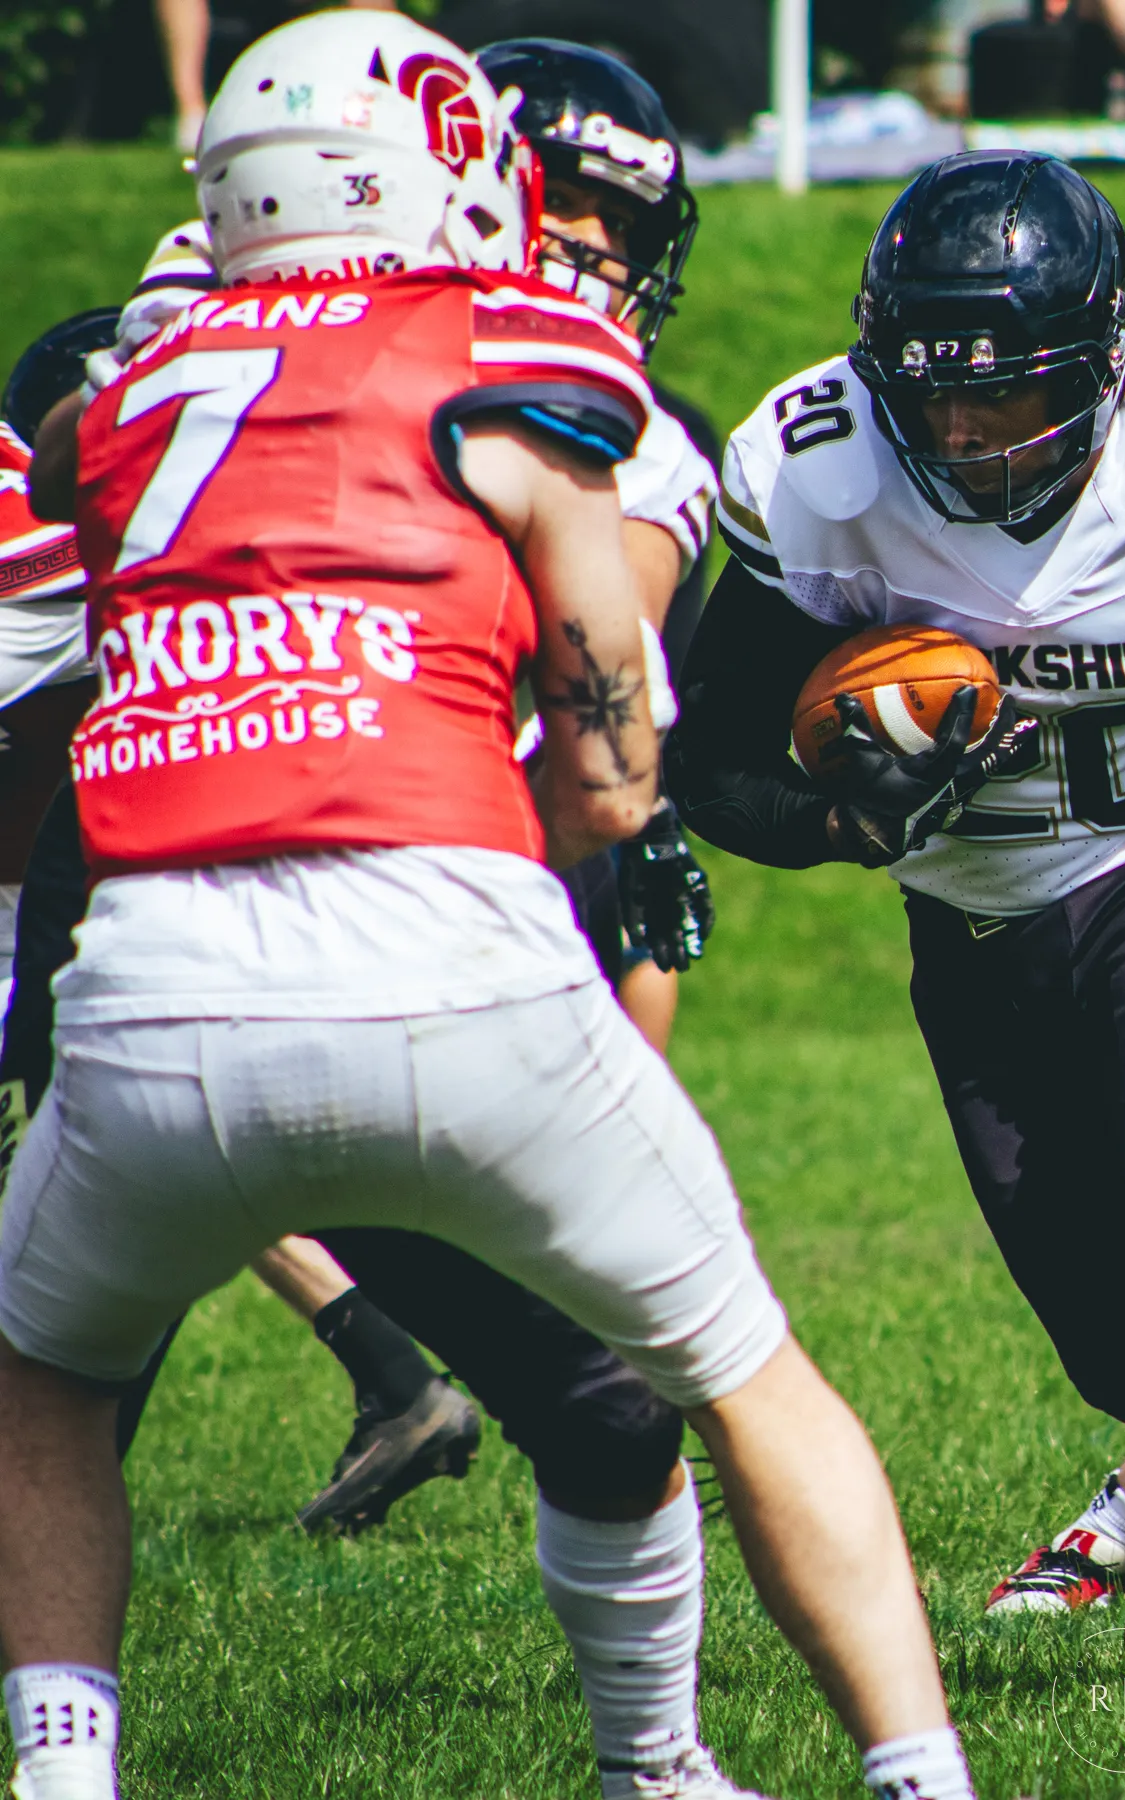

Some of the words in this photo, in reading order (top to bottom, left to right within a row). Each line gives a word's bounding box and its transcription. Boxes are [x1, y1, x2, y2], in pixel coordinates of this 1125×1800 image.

[935, 341, 959, 356] F7
[115, 347, 284, 575] 7
[773, 378, 857, 458] 20
[97, 592, 417, 707] CKORY'S
